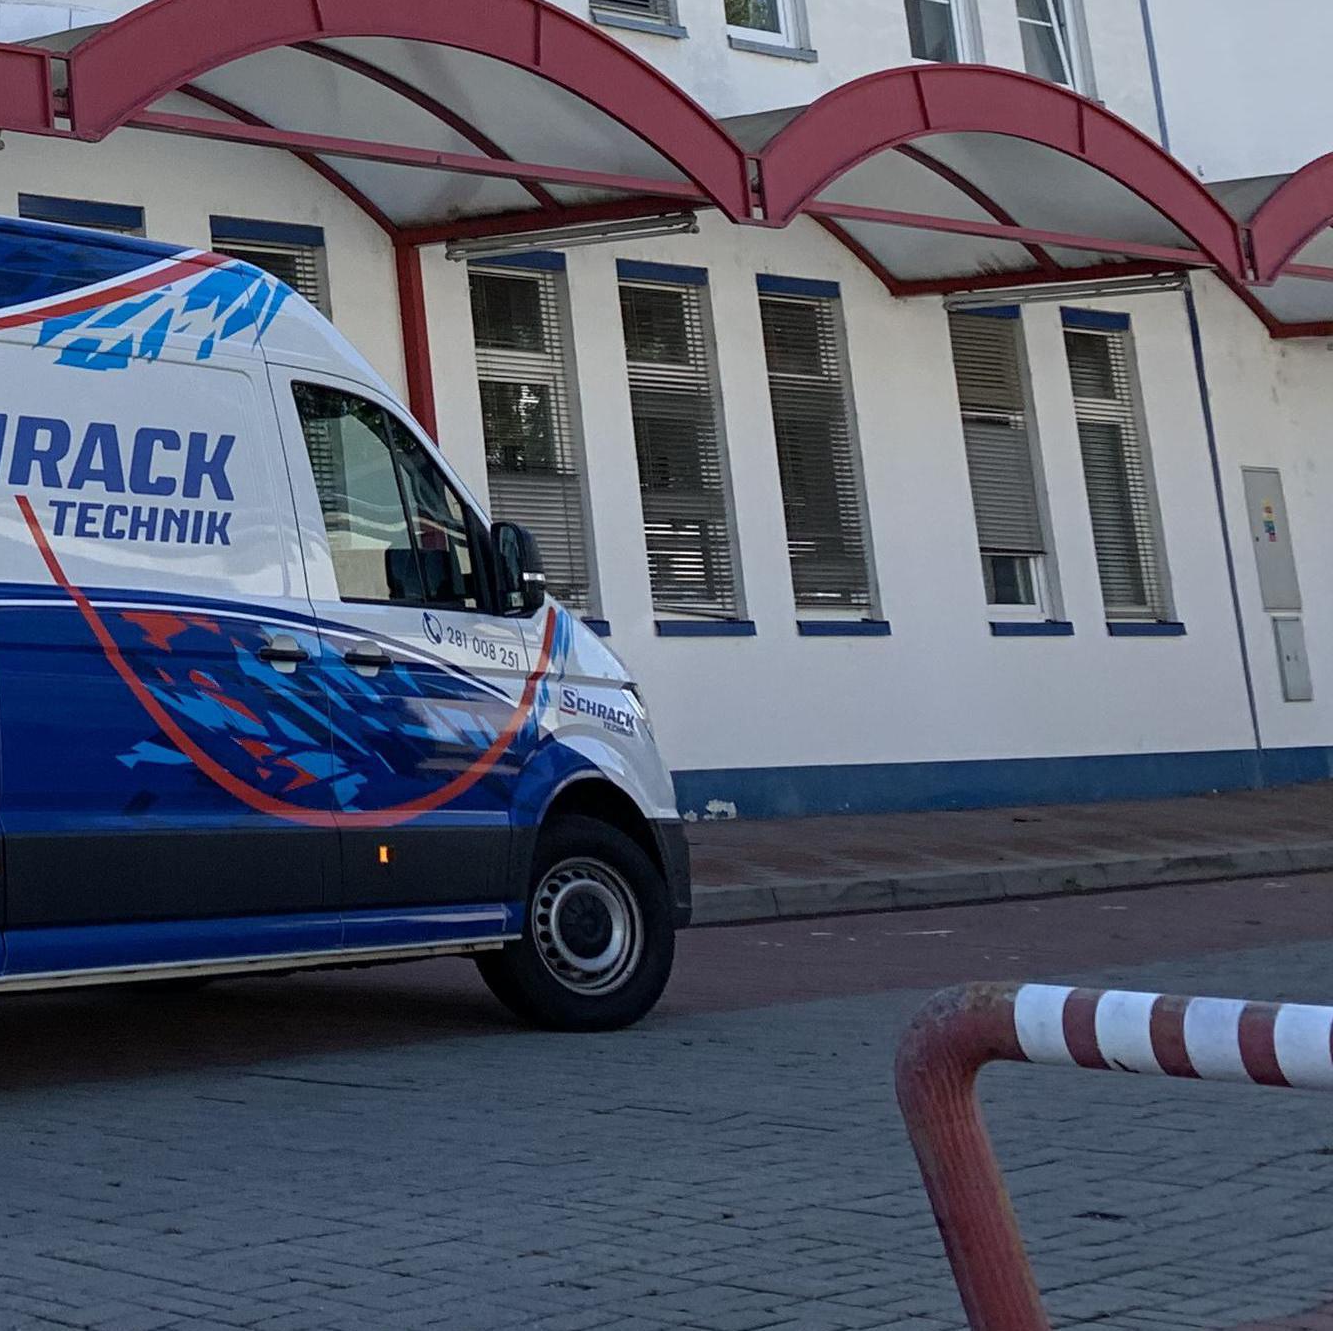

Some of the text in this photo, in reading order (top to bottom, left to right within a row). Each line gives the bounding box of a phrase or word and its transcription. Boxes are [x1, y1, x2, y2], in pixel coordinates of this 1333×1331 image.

[48, 499, 232, 546] TECHNIK
[446, 626, 520, 670] 281 008 251
[563, 689, 635, 729] SCHRACK
